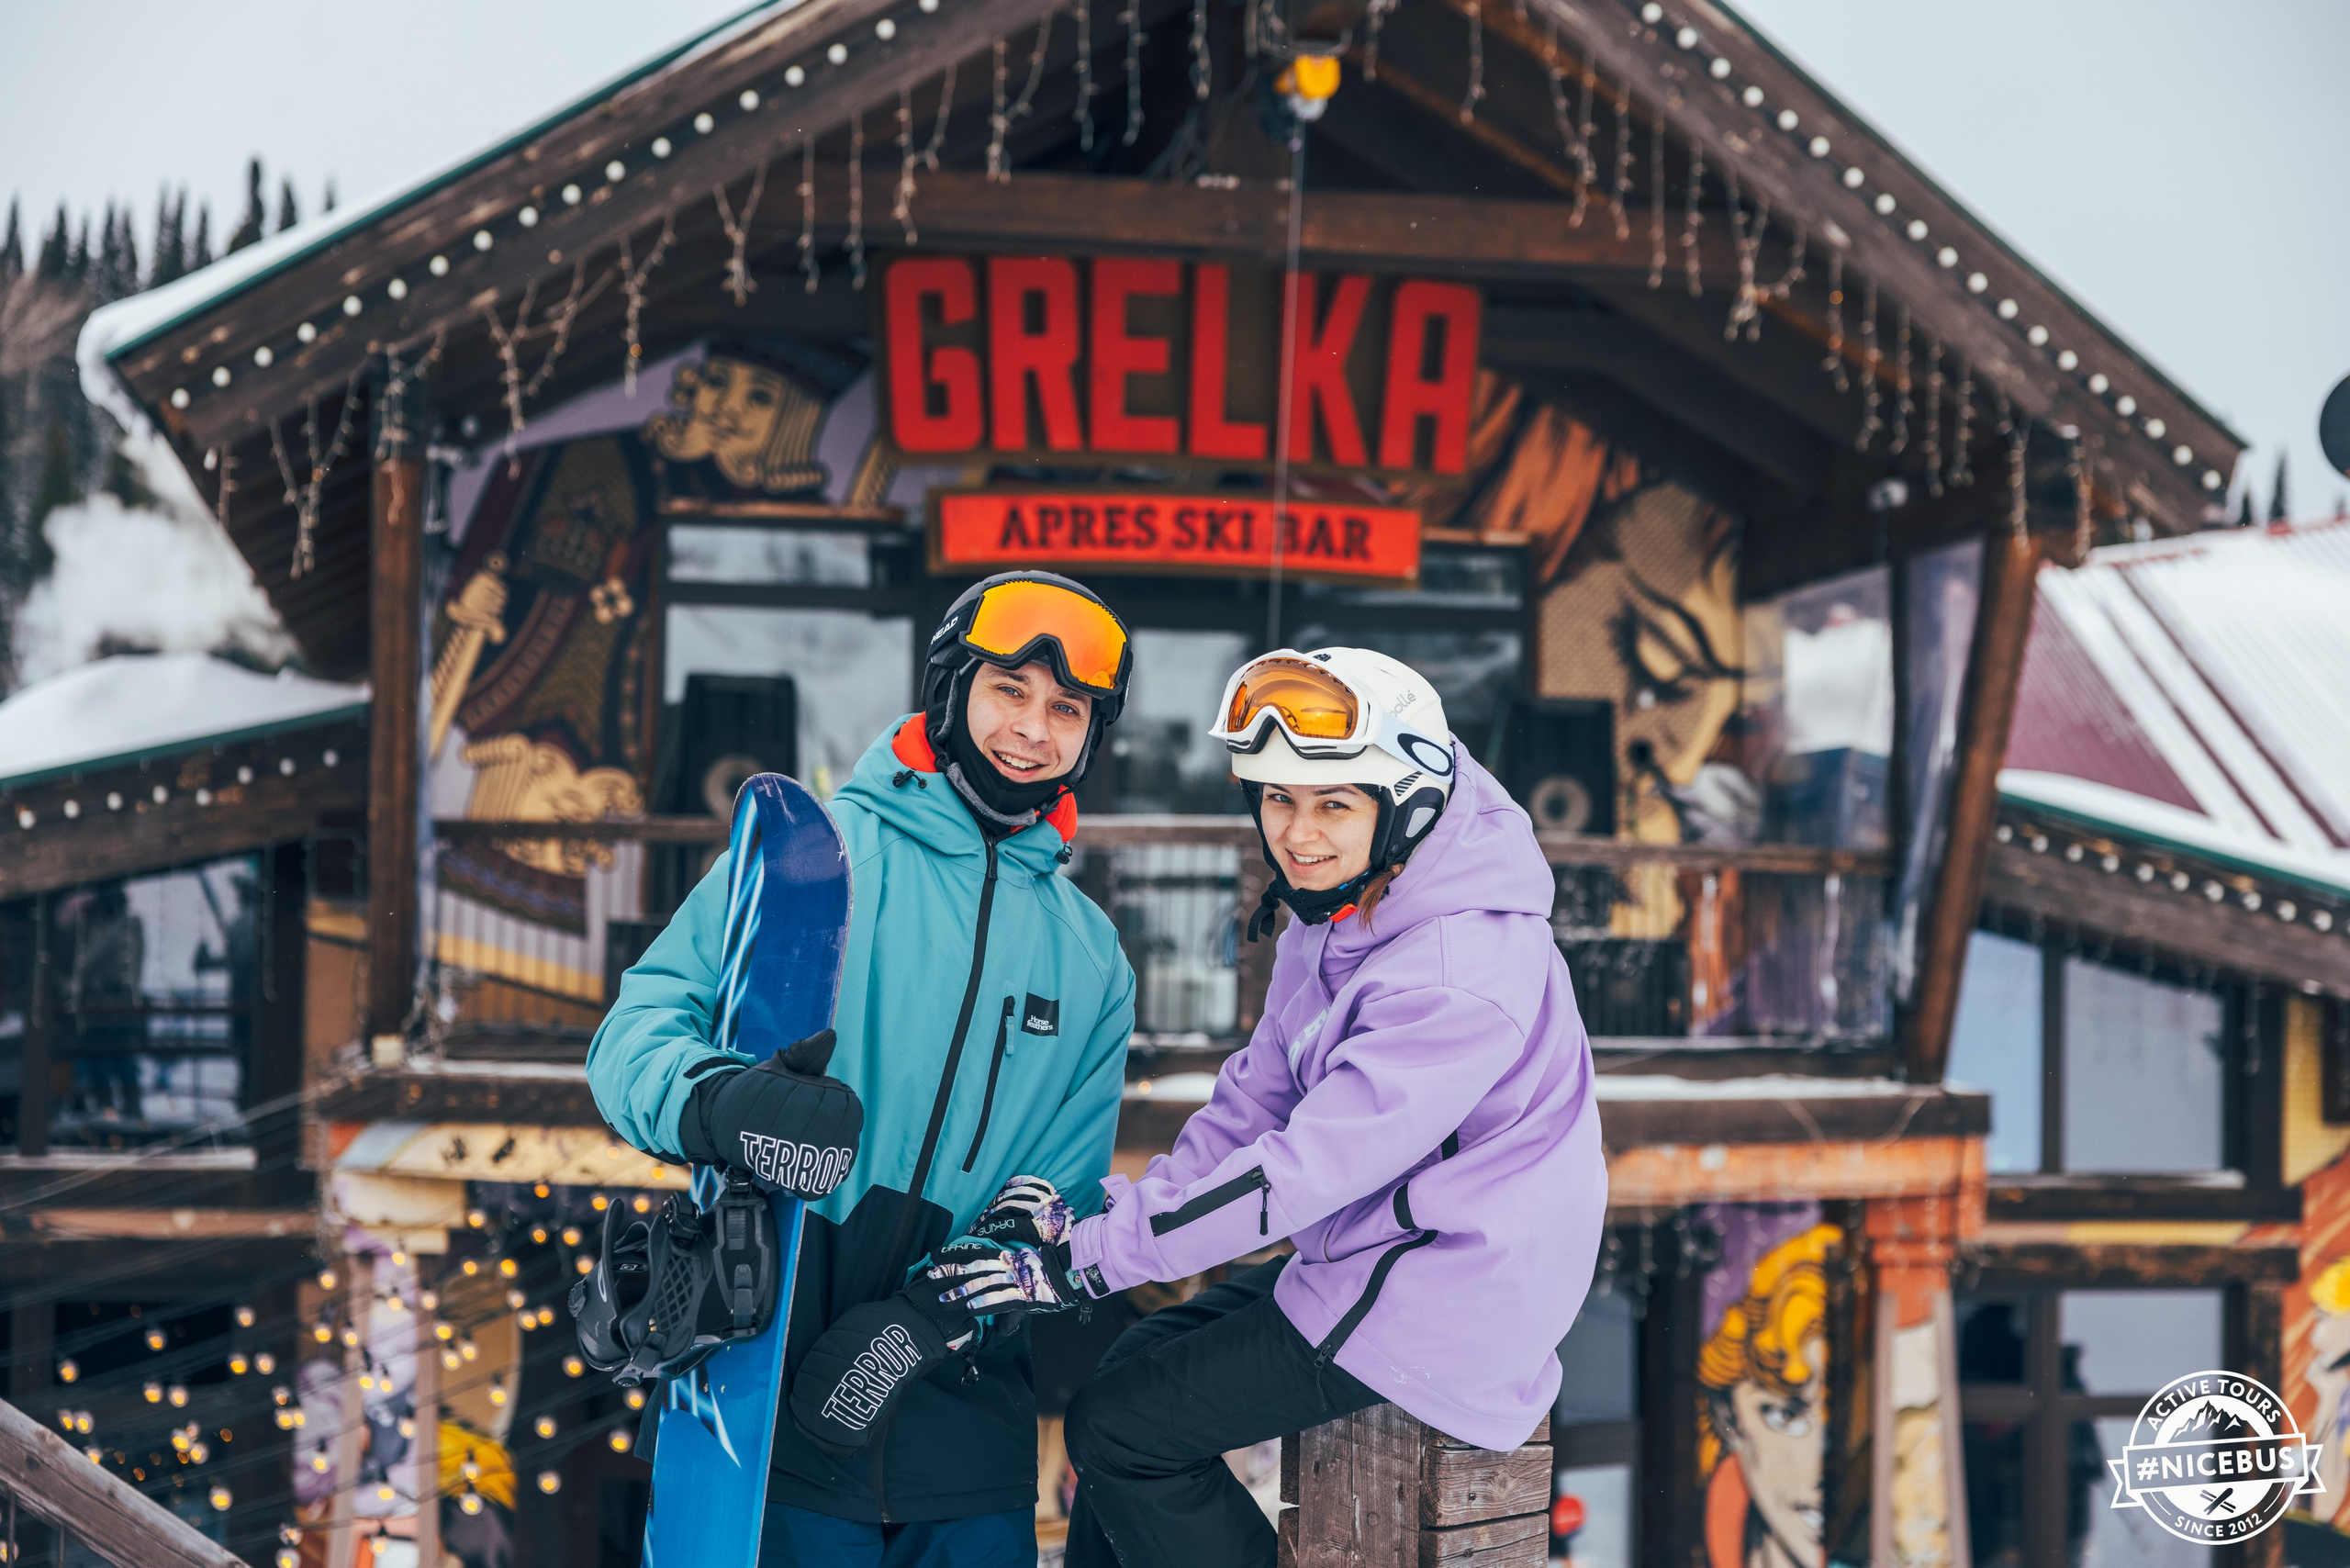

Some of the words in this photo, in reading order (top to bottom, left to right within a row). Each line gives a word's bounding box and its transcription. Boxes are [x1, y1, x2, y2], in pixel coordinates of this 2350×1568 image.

[885, 256, 1483, 475] GRELKA
[999, 506, 1158, 549] APRES
[1172, 510, 1256, 552] SKI
[1273, 511, 1373, 562] BAR
[740, 1131, 853, 1194] TERROR
[821, 1324, 923, 1430] TERROR
